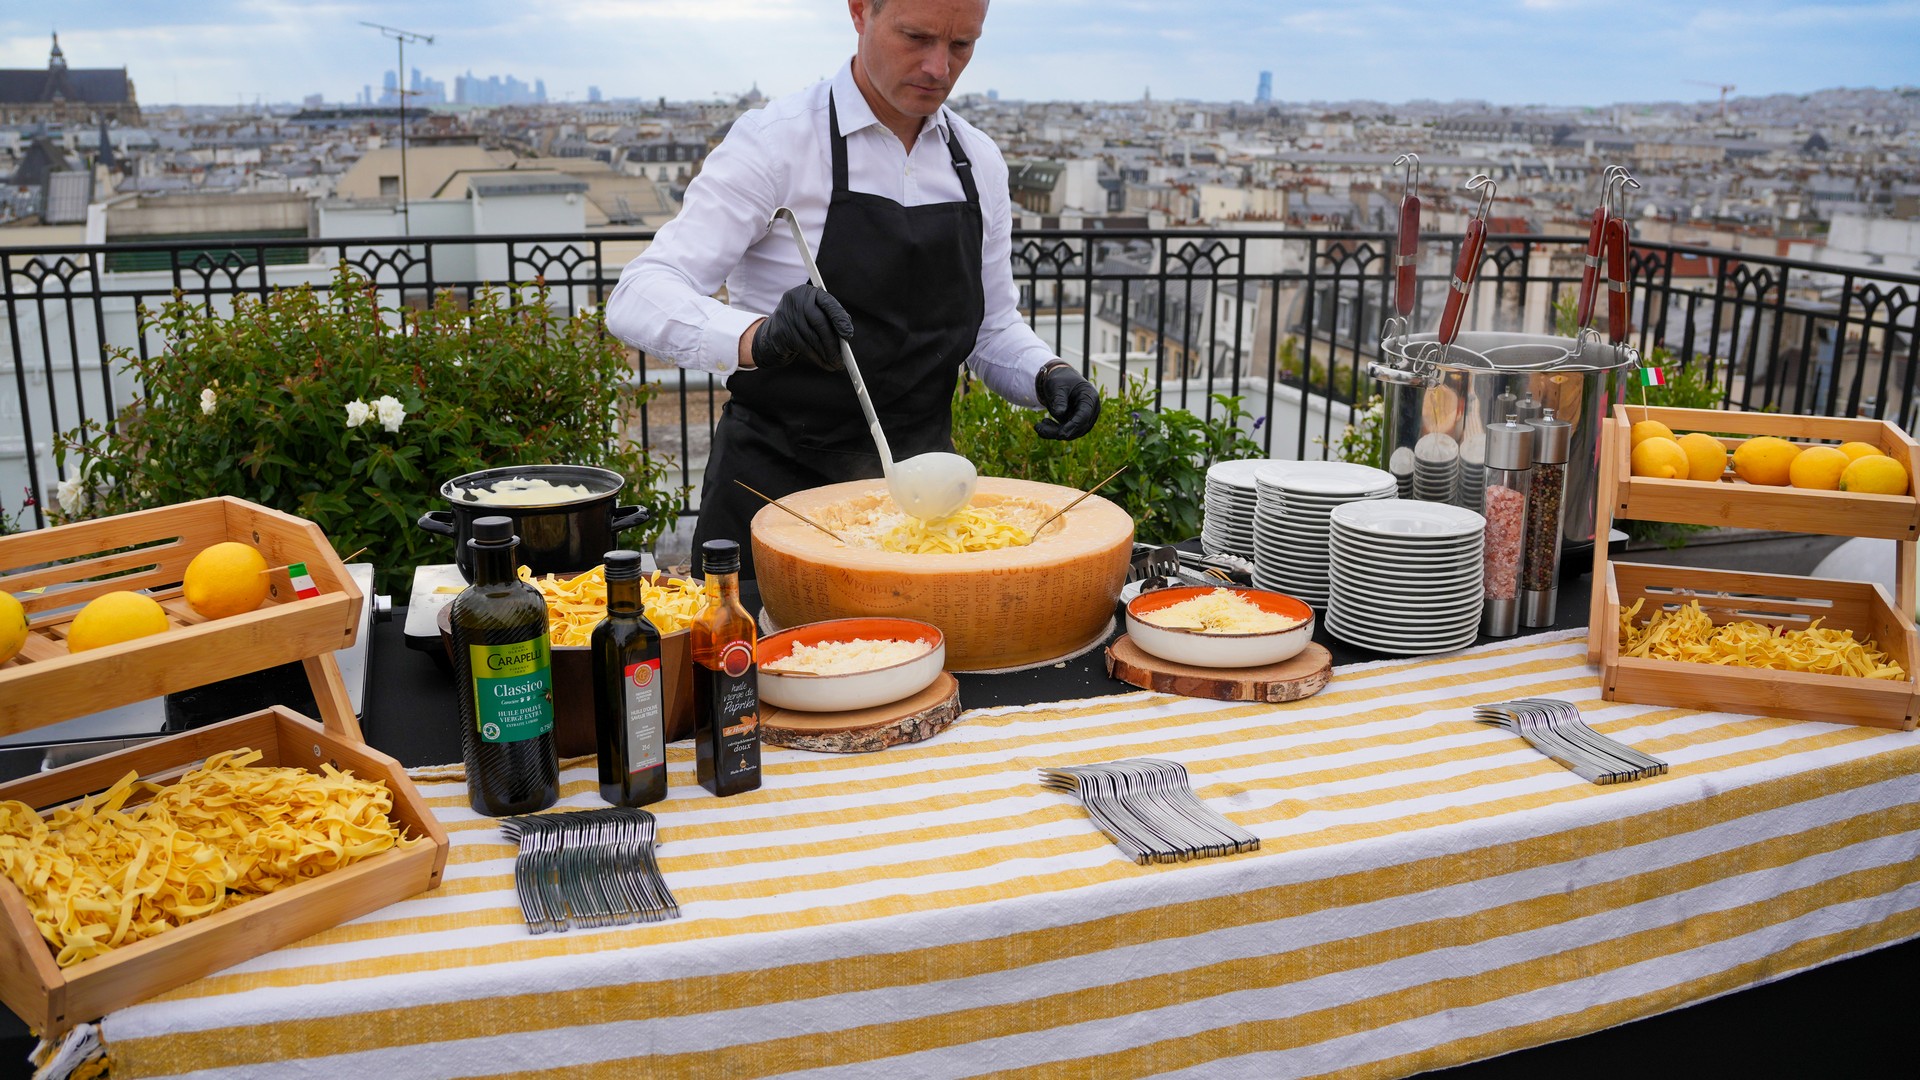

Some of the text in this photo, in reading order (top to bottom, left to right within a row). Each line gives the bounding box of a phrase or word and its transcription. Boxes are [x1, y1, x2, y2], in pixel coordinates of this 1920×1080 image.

[487, 649, 542, 671] CARAPELLI
[493, 679, 543, 698] Classico
[745, 688, 754, 697] de
[520, 704, 542, 715] D'OLIVE
[724, 697, 756, 716] Paprika
[500, 710, 543, 723] VIERGE EXTRA
[733, 744, 752, 753] doux
